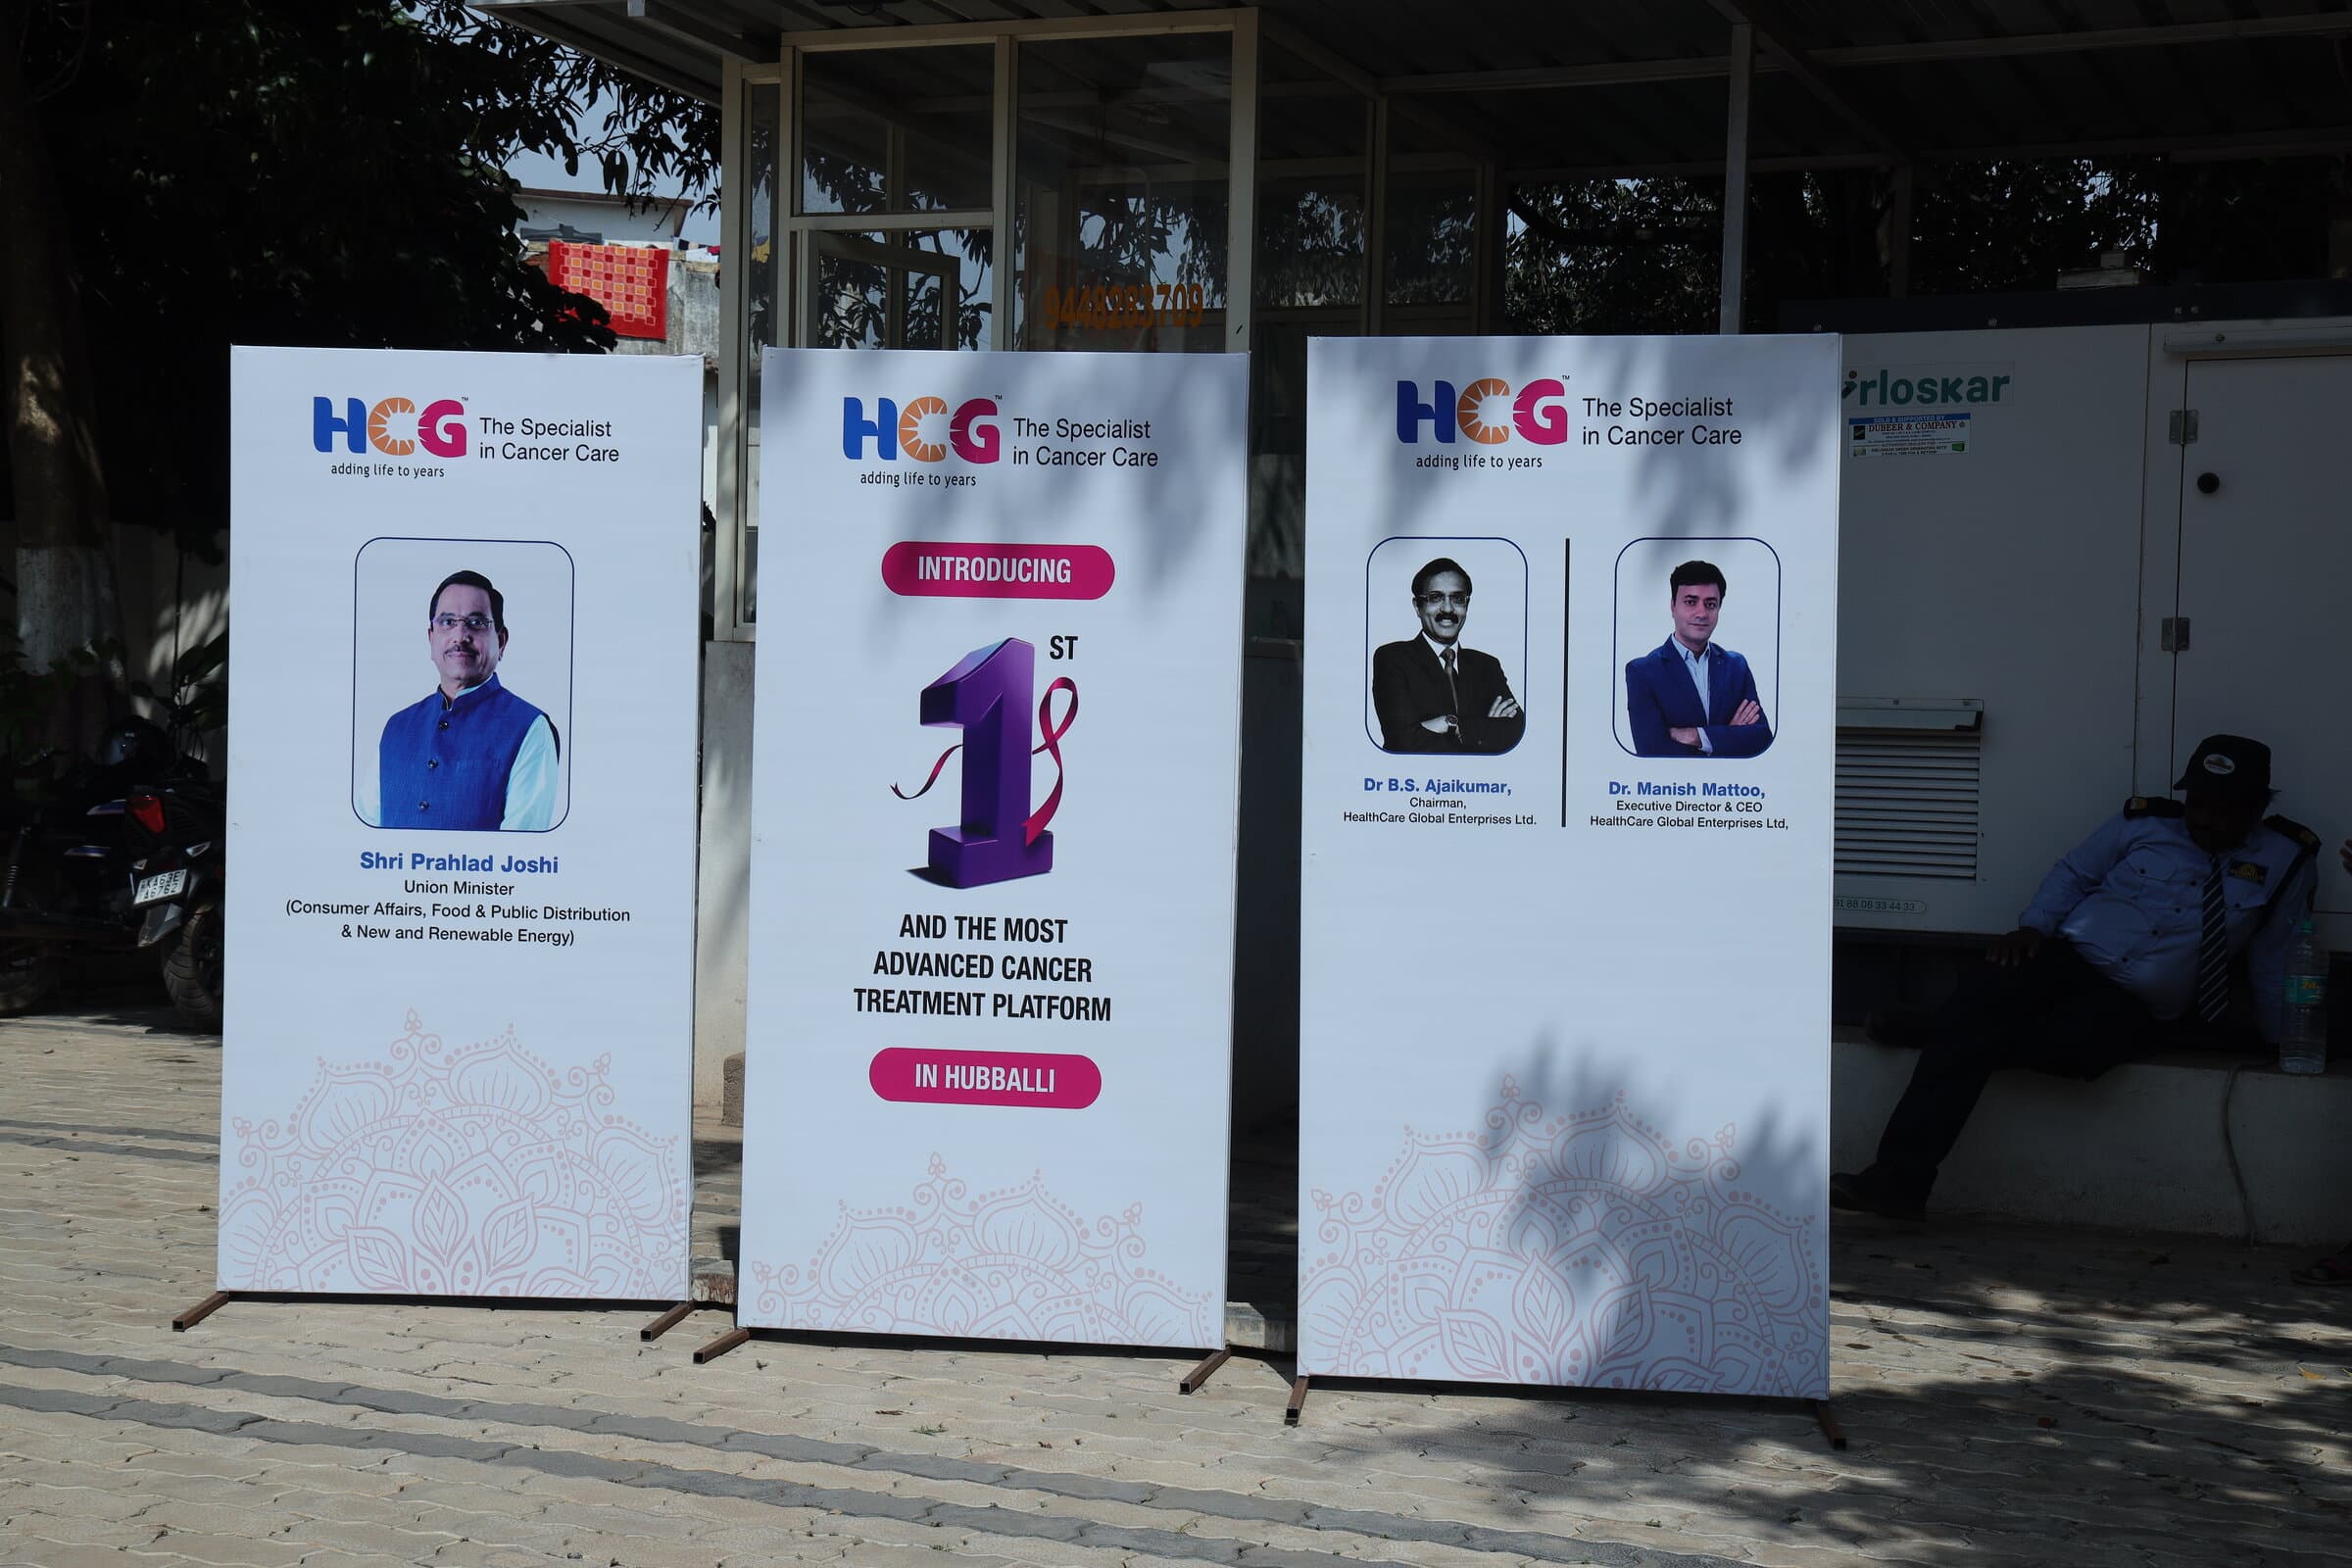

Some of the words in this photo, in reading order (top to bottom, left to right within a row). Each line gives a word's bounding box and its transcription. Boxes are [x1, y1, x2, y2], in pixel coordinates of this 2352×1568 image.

[1396, 377, 1568, 446] HCG
[1583, 398, 1622, 416] The
[1629, 397, 1733, 421] Specialist
[313, 396, 467, 458] HCG
[479, 417, 514, 434] The
[521, 418, 612, 439] Specialist
[843, 396, 1001, 465] HCG
[1013, 418, 1049, 437] The
[1056, 418, 1151, 442] Specialist
[1915, 420, 1957, 429] COMPANY
[1583, 426, 1599, 445] in
[1607, 426, 1685, 446] Cancer
[1691, 426, 1742, 445] Care
[480, 442, 494, 459] in
[503, 443, 569, 461] Cancer
[576, 444, 618, 462] Care
[1012, 446, 1029, 466] in
[1036, 446, 1106, 466] Cancer
[1112, 447, 1158, 467] Care
[1416, 455, 1460, 470] adding
[1464, 455, 1486, 467] life
[1491, 456, 1503, 467] to
[1508, 458, 1542, 470] years
[331, 463, 369, 477] adding
[374, 464, 393, 475] life
[398, 466, 410, 476] to
[414, 468, 444, 478] years
[860, 471, 900, 487] adding
[905, 472, 924, 485] life
[929, 474, 940, 485] to
[945, 476, 976, 489] years
[917, 555, 1070, 583] INTRODUCING
[1050, 635, 1078, 660] ST
[1364, 778, 1383, 791] Dr
[1389, 778, 1419, 792] B.S.
[1425, 779, 1511, 796] Ajaikumar,
[1609, 782, 1631, 795] Dr.
[1638, 782, 1695, 796] Manish
[1702, 783, 1765, 799] Mattoo,
[1410, 797, 1466, 809] Chairman,
[1617, 801, 1672, 810] Executive
[1676, 801, 1721, 811] Director
[1725, 802, 1733, 811] &
[1737, 802, 1762, 812] CEO
[1344, 811, 1405, 822] HealthCare
[1409, 812, 1445, 823] Global
[1448, 813, 1511, 826] Enterprises
[1516, 815, 1536, 824] Ltd.
[1591, 815, 1653, 826] HealthCare
[1657, 816, 1693, 827] Global
[1698, 817, 1762, 830] Enterprises
[361, 852, 403, 869] Shri
[412, 854, 493, 871] Prahlad
[501, 856, 558, 873] Joshi
[405, 880, 448, 894] Union
[454, 881, 514, 895] Minister
[286, 900, 369, 915] (Consumer
[373, 903, 425, 918] Affairs,
[432, 904, 470, 917] Food
[475, 905, 486, 917] &
[492, 906, 538, 919] Public
[544, 906, 629, 921] Distribution
[342, 924, 352, 937] &
[358, 925, 390, 938] New
[396, 926, 423, 939] and
[429, 927, 513, 941] Renewable
[518, 929, 573, 946] Energy)
[900, 914, 946, 939] AND
[955, 916, 996, 941] THE
[1004, 917, 1067, 943] MOST
[873, 952, 994, 978] ADVANCED
[1003, 956, 1092, 982] CANCER
[854, 988, 986, 1016] TREATMENT
[994, 994, 1110, 1021] PLATFORM
[915, 1064, 938, 1088] IN
[945, 1065, 1055, 1093] HUBBALLI
